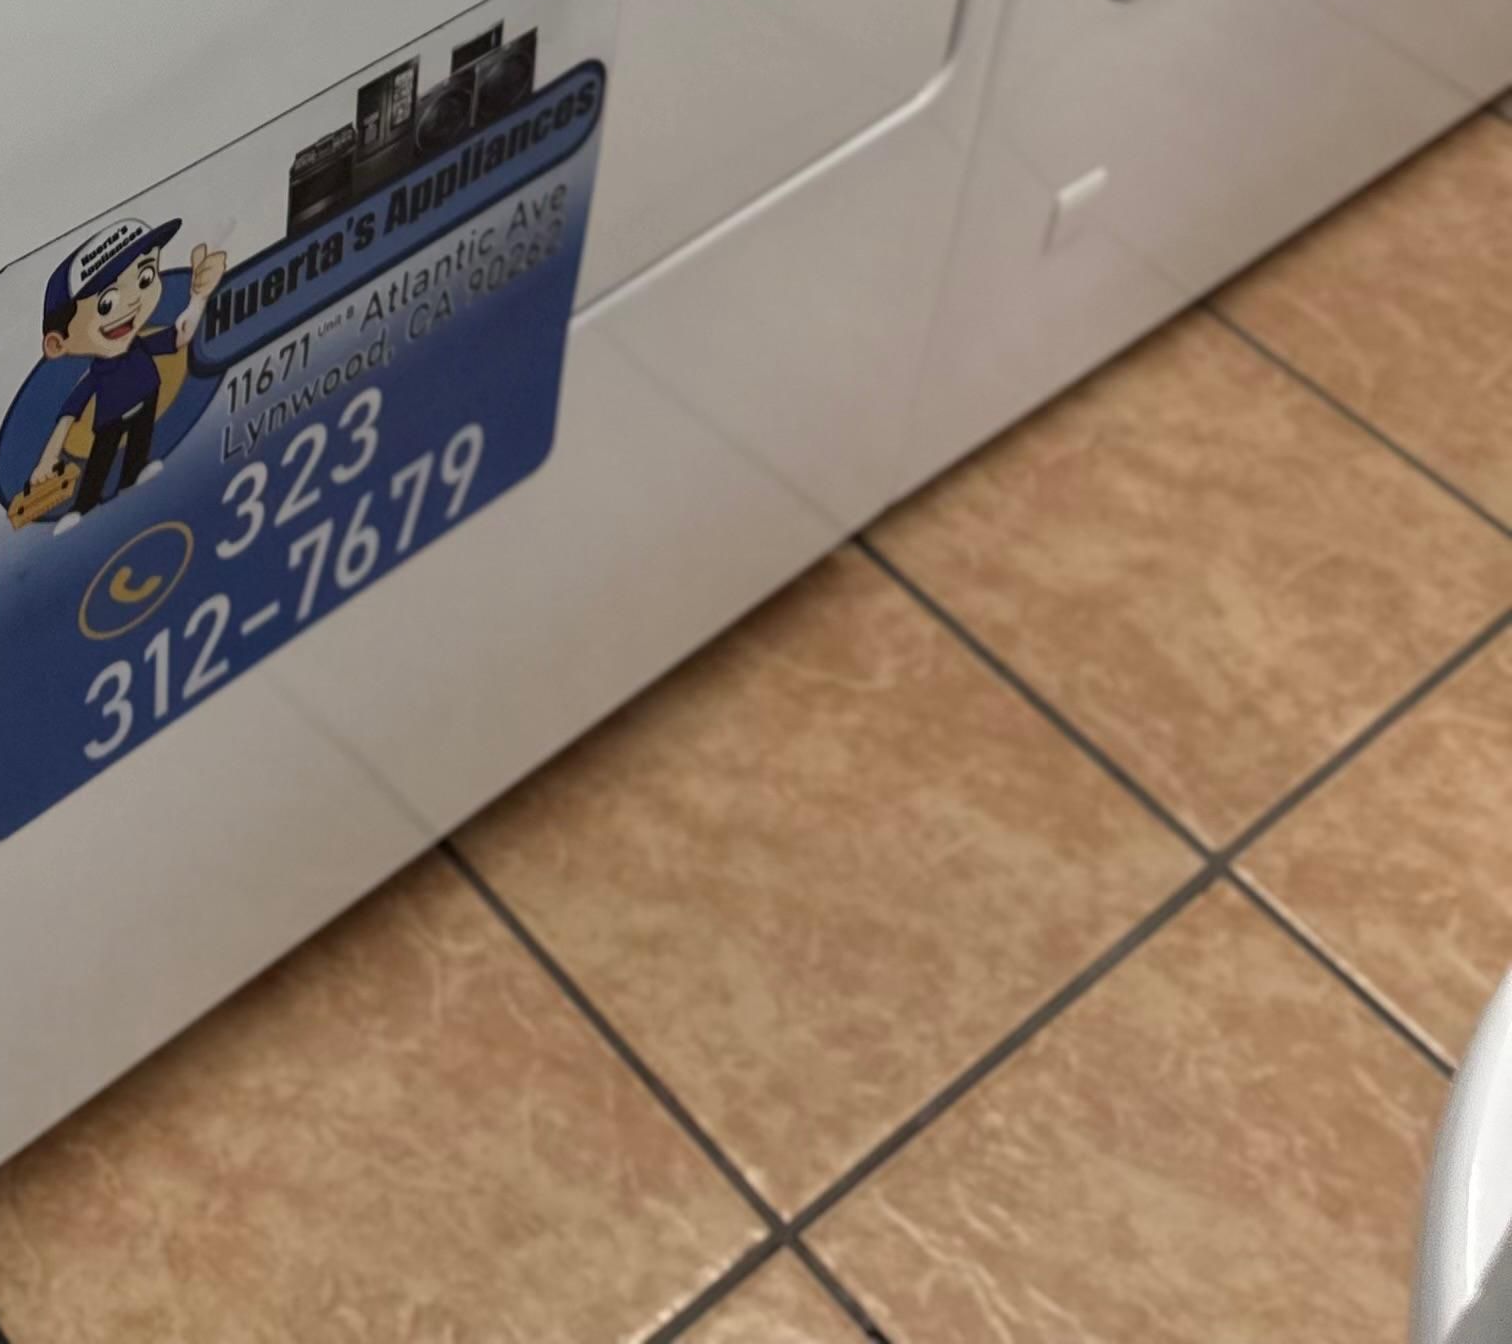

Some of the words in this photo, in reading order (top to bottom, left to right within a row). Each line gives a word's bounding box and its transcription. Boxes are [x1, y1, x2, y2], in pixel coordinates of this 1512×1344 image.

[80, 226, 143, 282] Appliances
[81, 225, 128, 267] Huerta's
[205, 212, 376, 343] Huerta's
[383, 79, 597, 236] Appliances
[220, 327, 393, 463] Lynwood,
[407, 290, 454, 343] CA
[226, 332, 313, 415] 11671
[317, 313, 342, 338] Unit
[360, 223, 495, 333] Atlantic
[505, 182, 568, 235] Ave
[215, 386, 383, 559] 323
[83, 422, 485, 759] 312-7679
